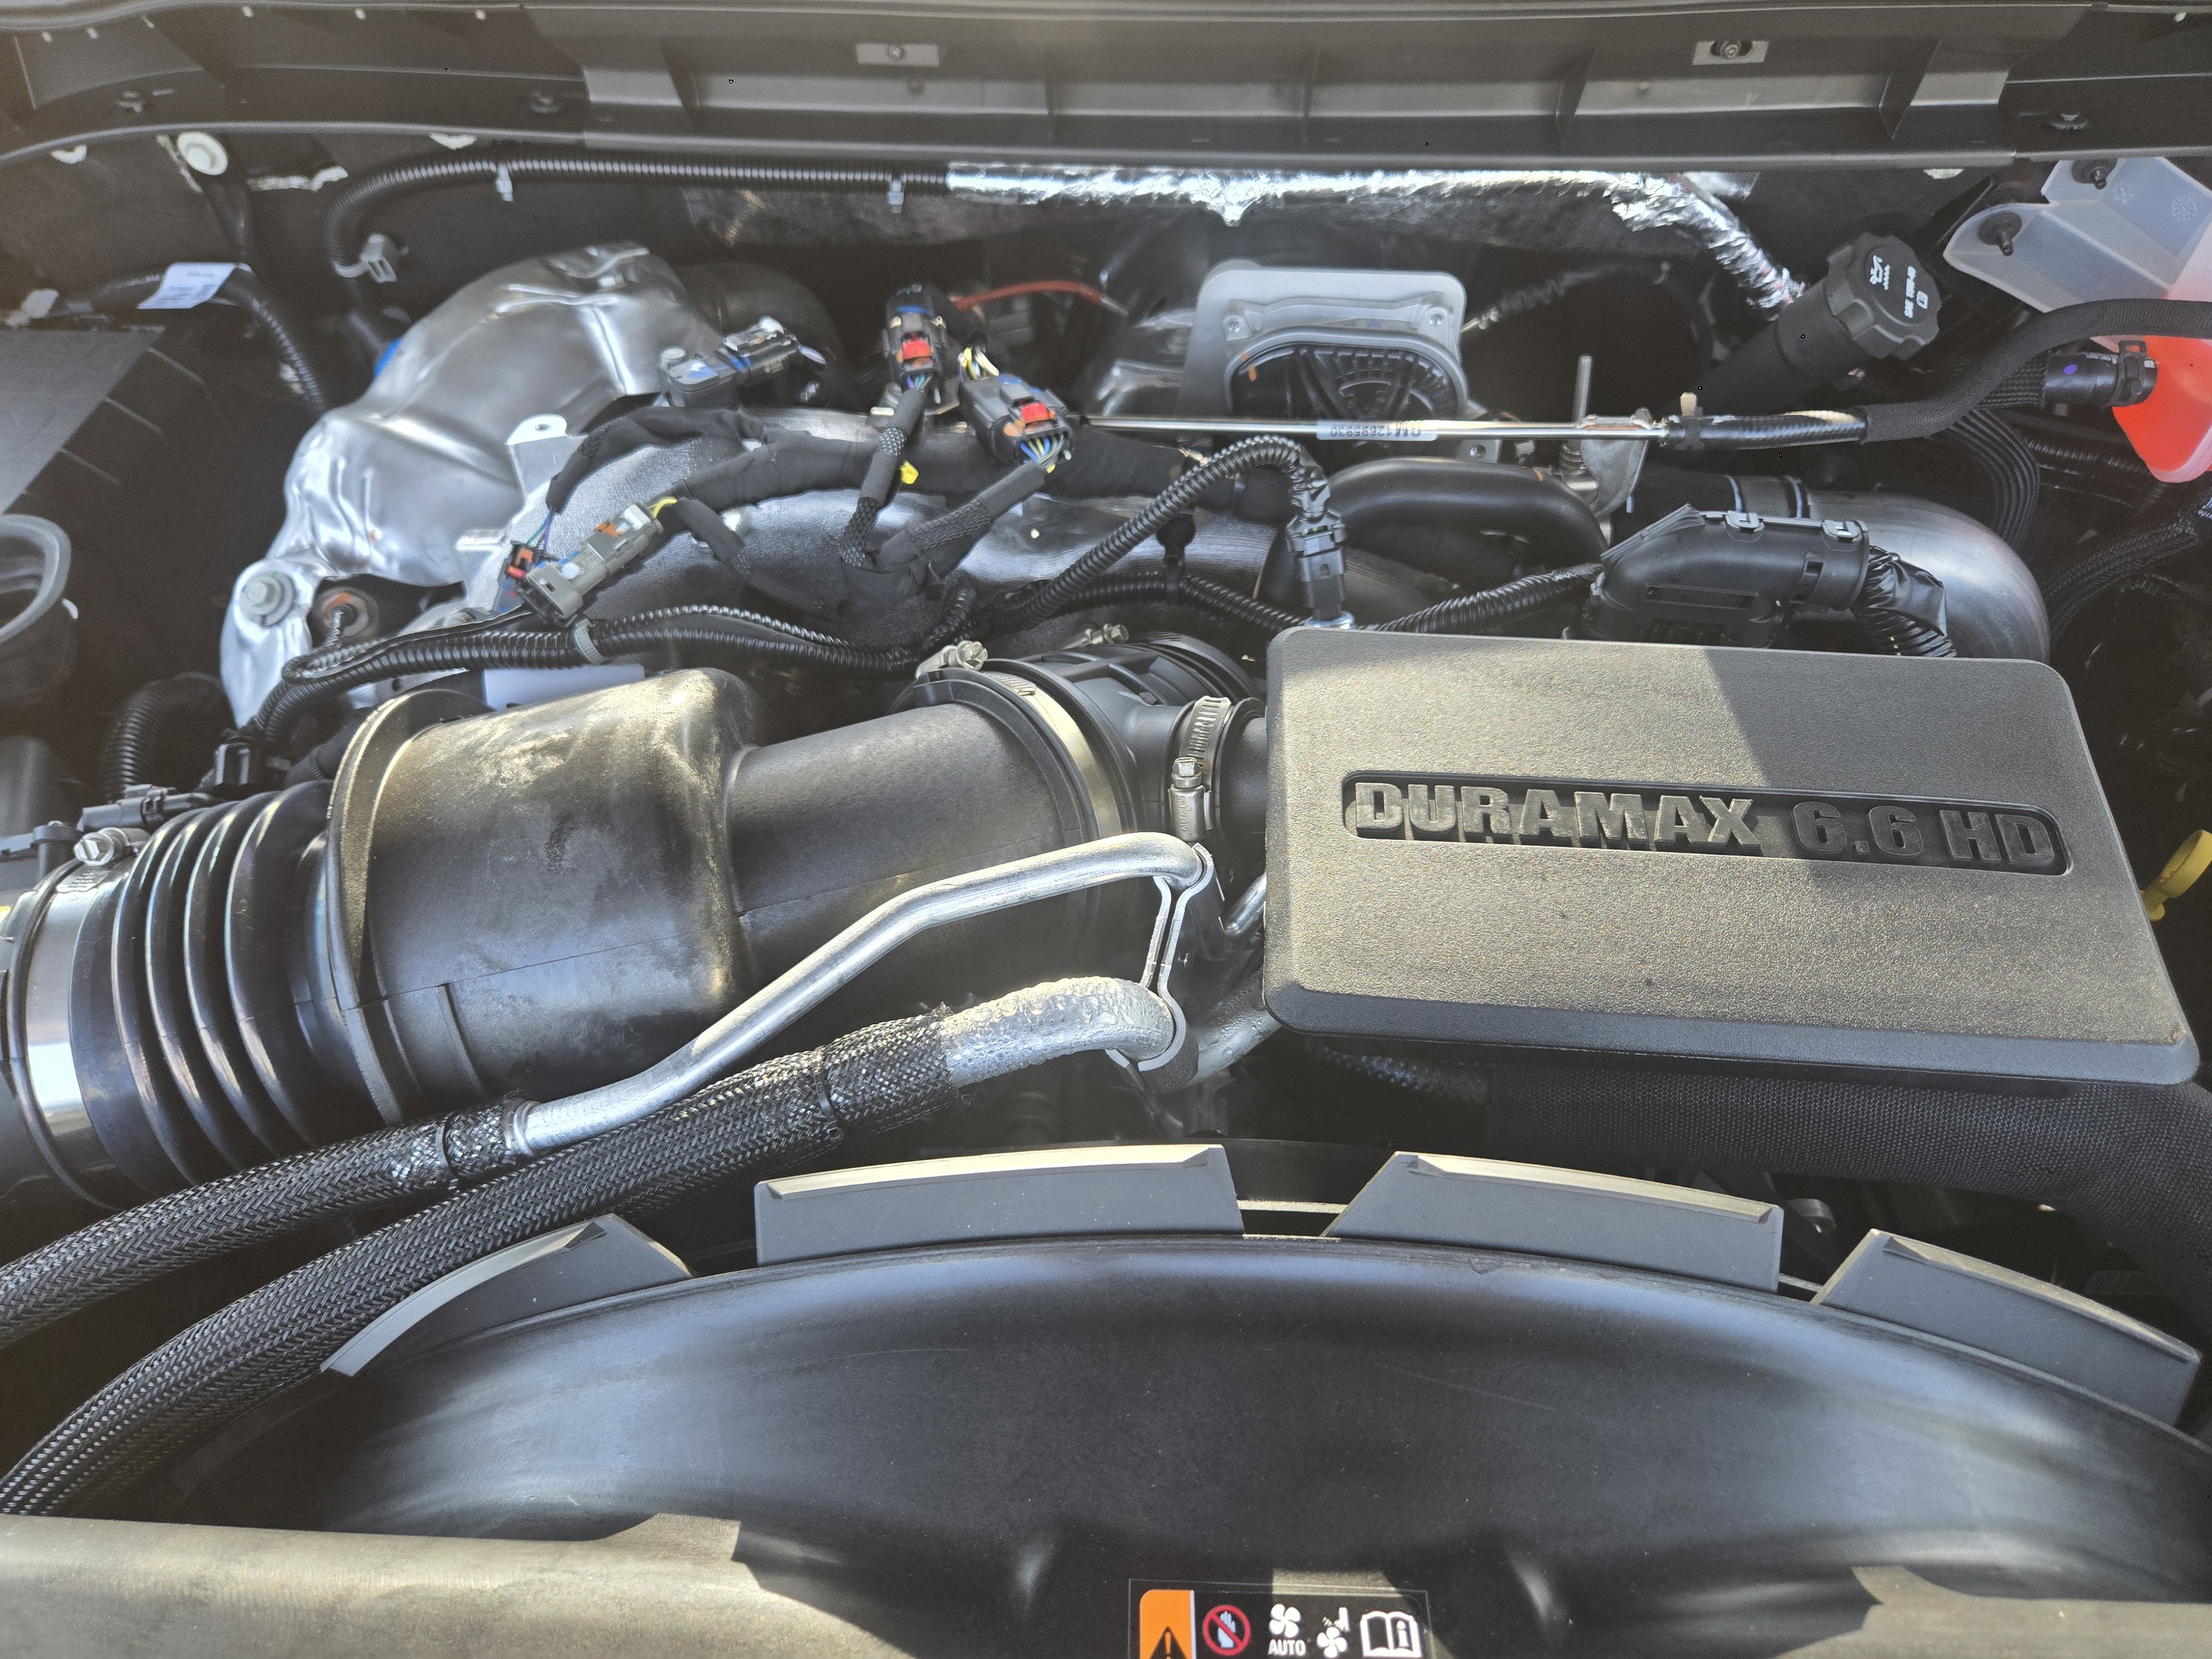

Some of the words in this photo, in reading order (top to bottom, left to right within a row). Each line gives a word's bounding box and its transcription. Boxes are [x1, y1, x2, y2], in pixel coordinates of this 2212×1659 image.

[1355, 782, 1761, 846] DURAMAX
[1792, 801, 1924, 857] 6.6
[1939, 810, 2055, 864] HD
[1267, 1639, 1306, 1656] AUTO
